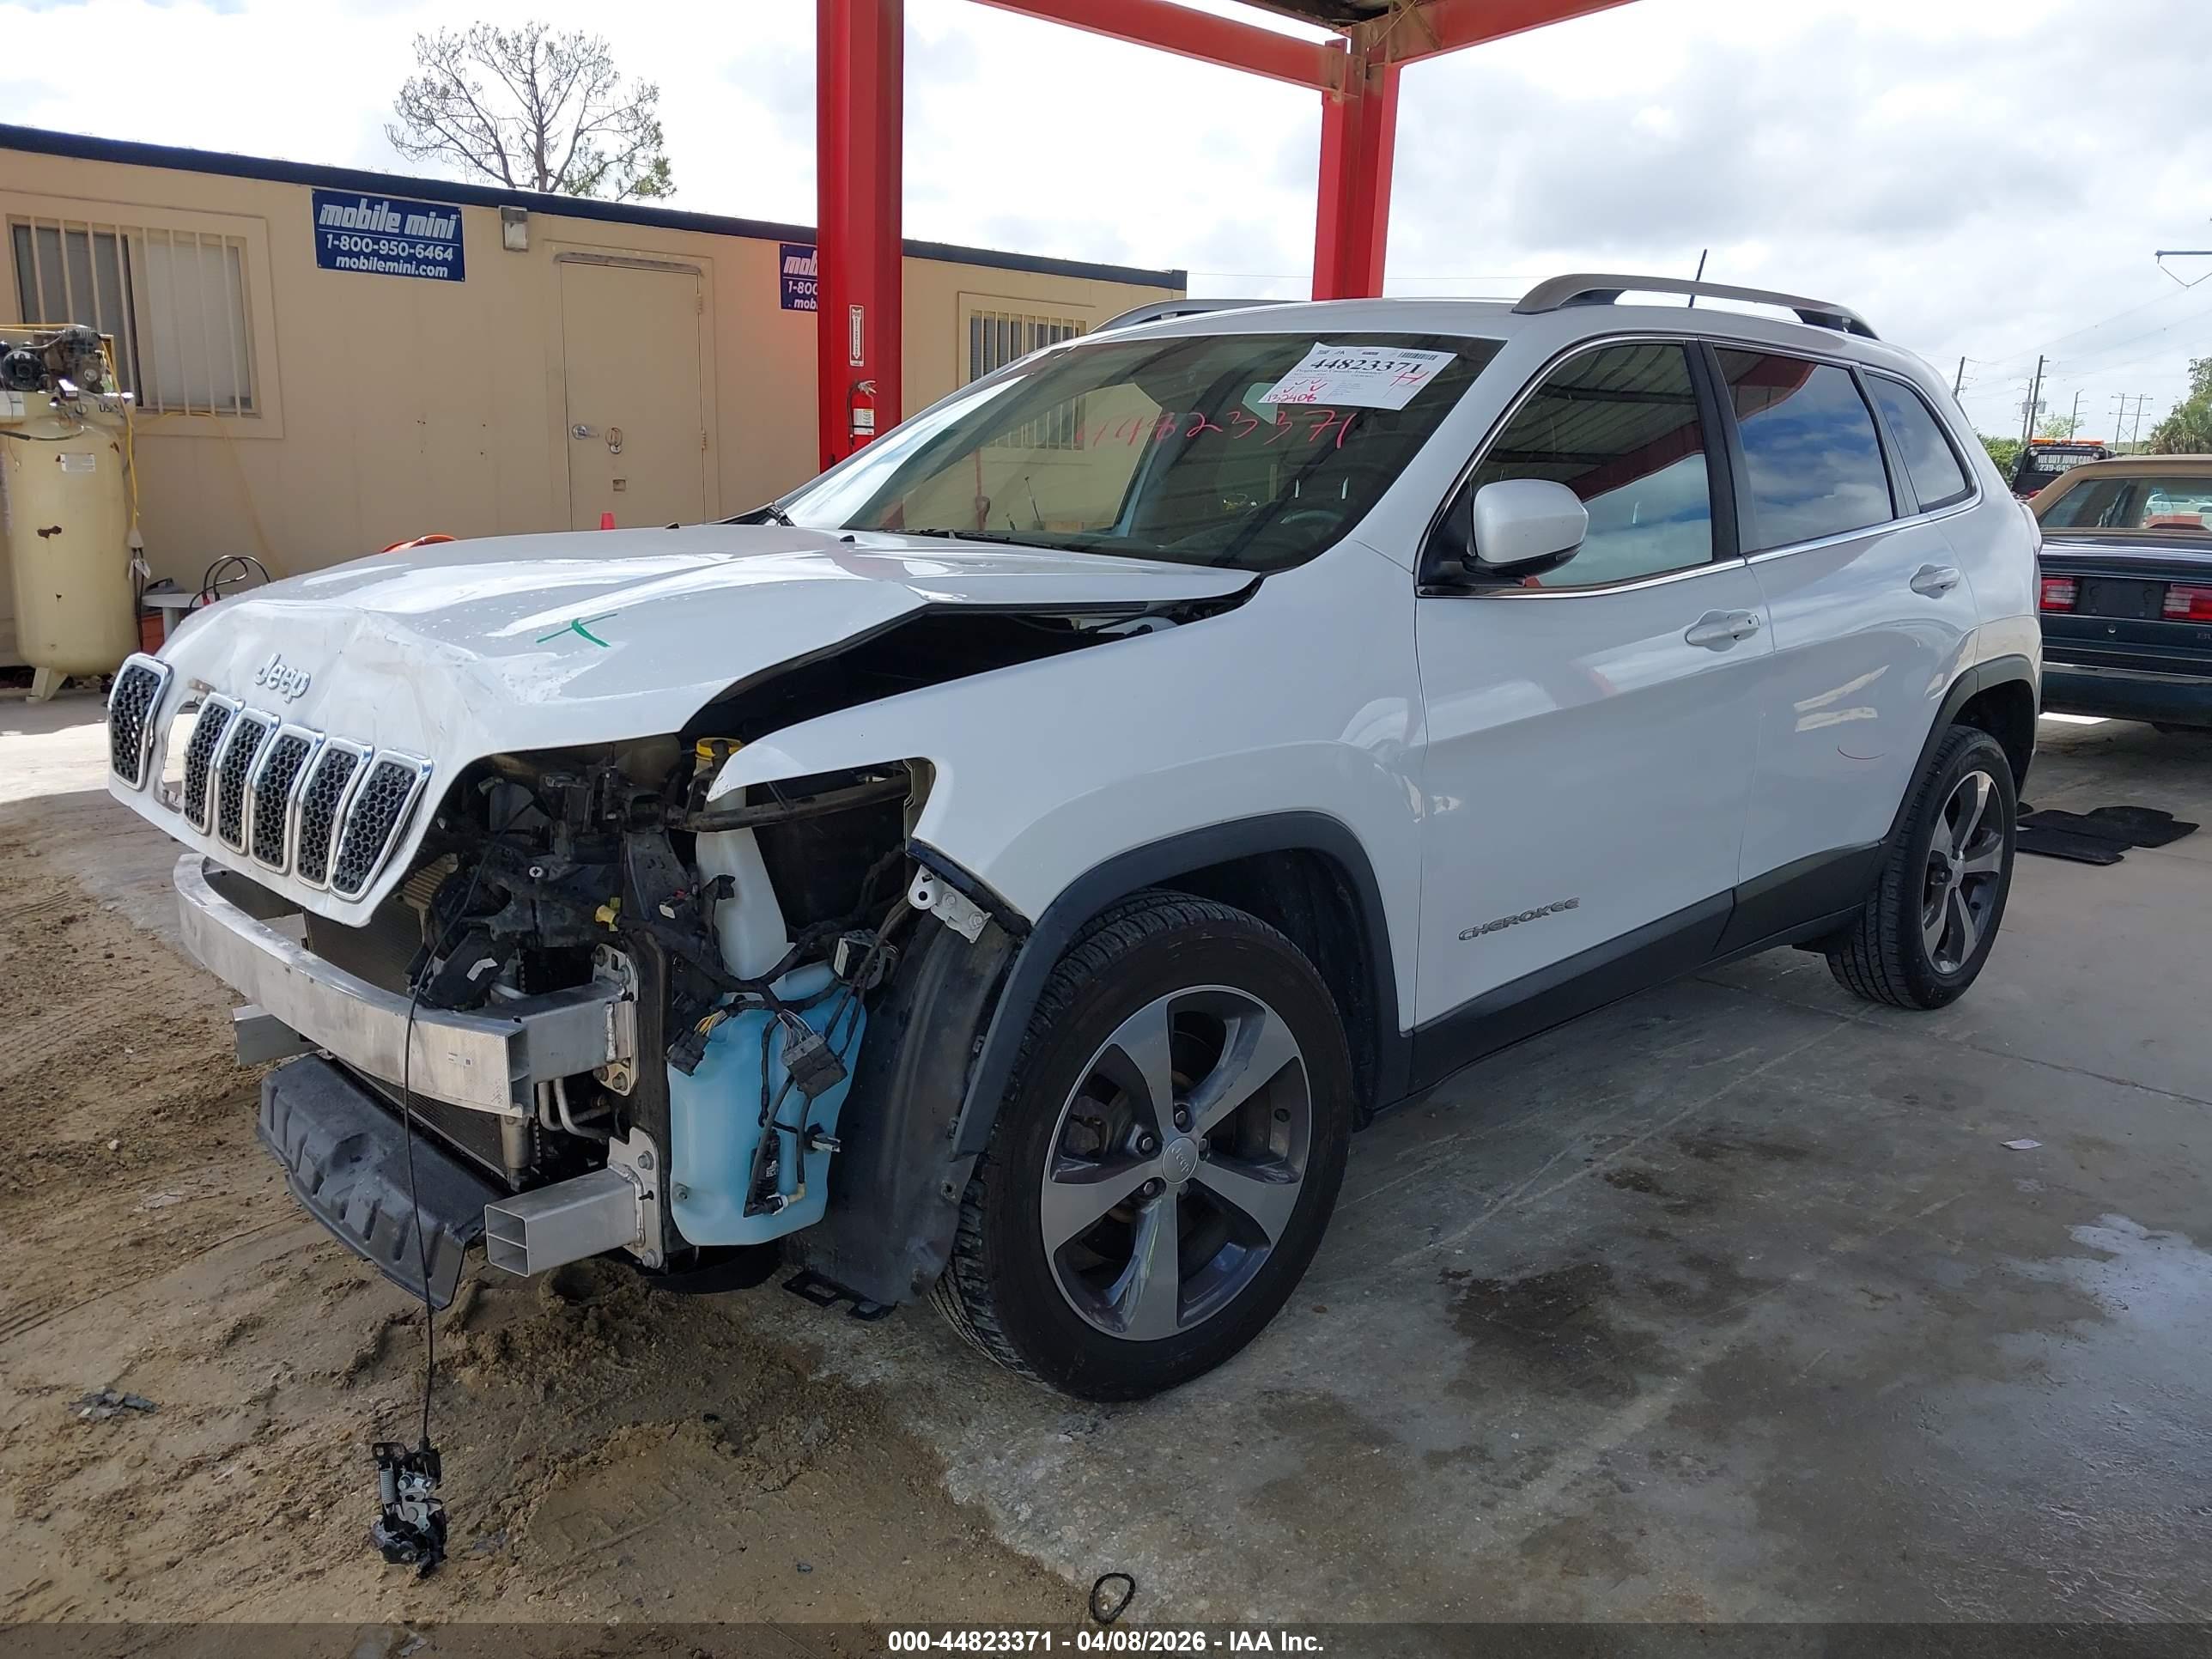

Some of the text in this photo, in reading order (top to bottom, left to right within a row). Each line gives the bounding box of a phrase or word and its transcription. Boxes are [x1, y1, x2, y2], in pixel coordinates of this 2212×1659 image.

[319, 198, 458, 240] mobile mini
[326, 234, 453, 261] 1-800-950-6464
[336, 256, 448, 278] mobilemini.com
[793, 298, 817, 309] mob
[1310, 358, 1422, 374] 44823371
[254, 653, 311, 704] Jeep
[1459, 897, 1580, 940] CHEROKEE
